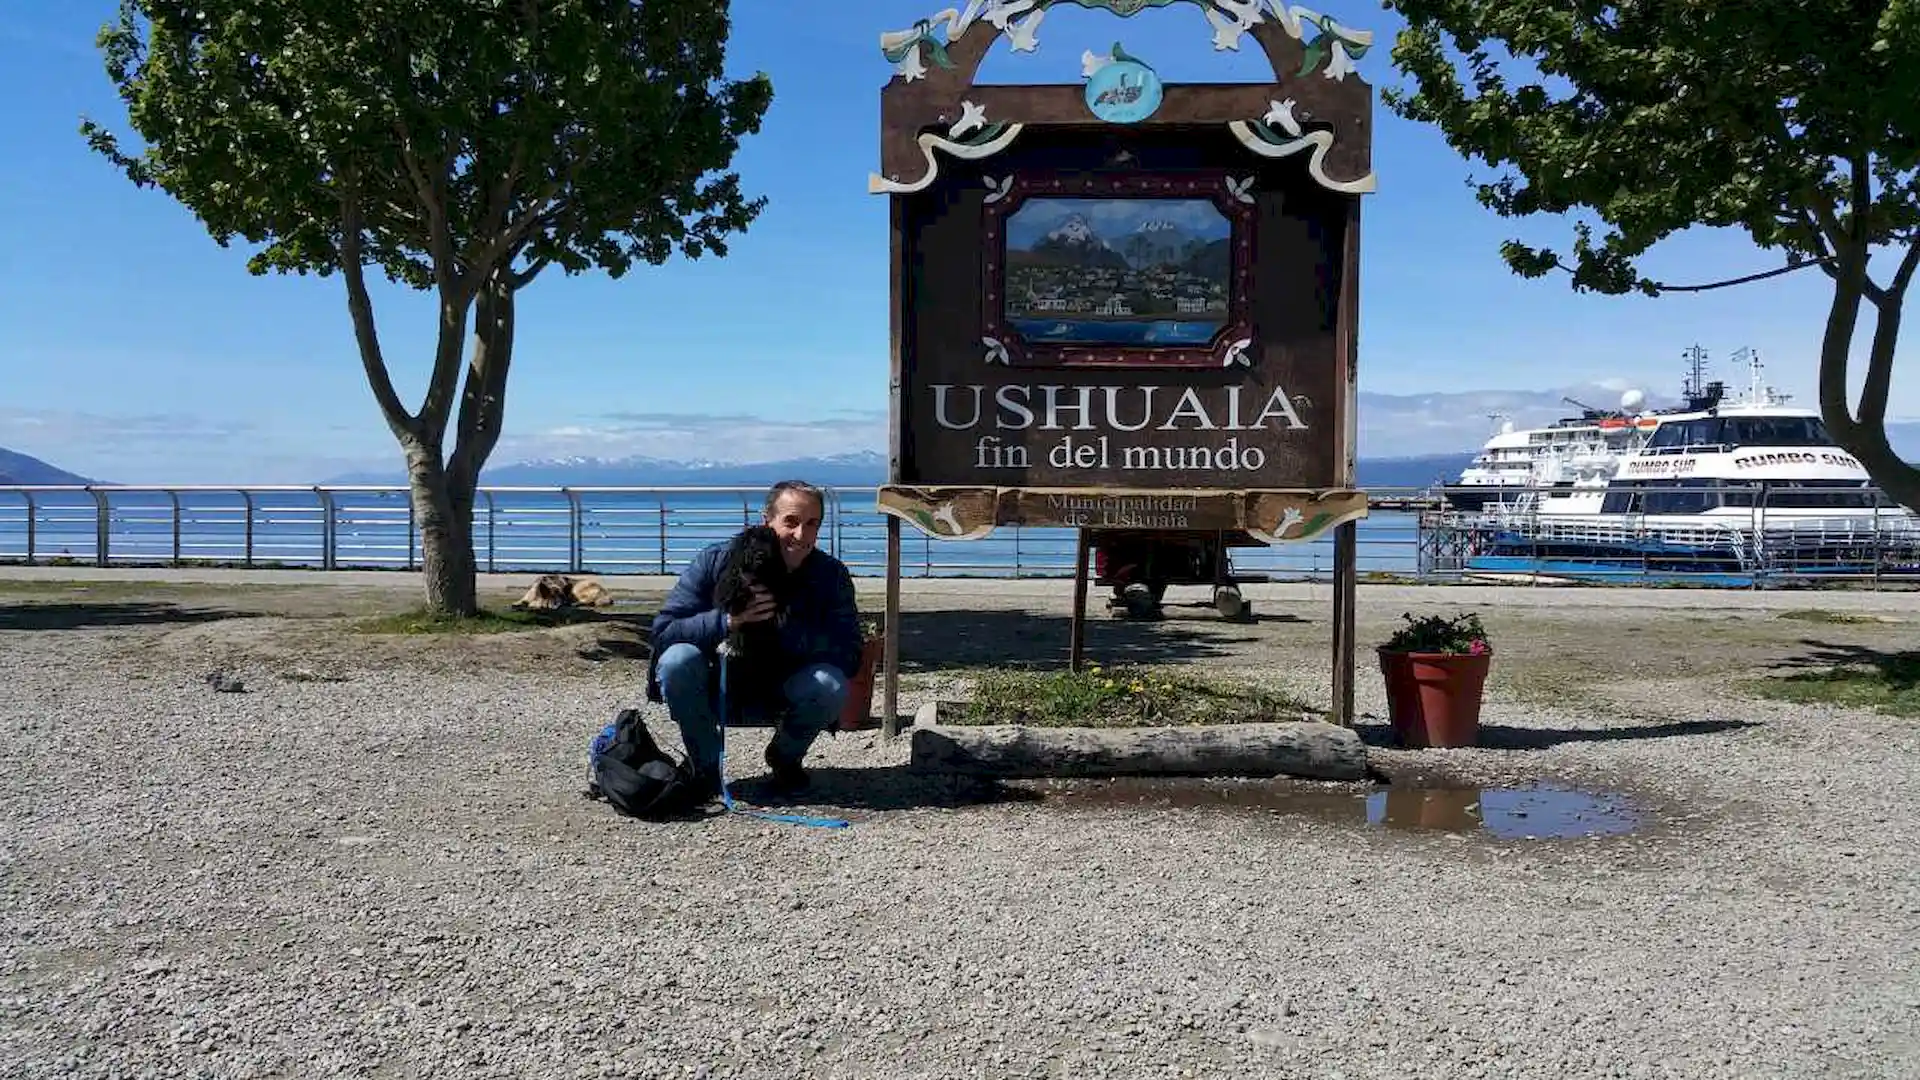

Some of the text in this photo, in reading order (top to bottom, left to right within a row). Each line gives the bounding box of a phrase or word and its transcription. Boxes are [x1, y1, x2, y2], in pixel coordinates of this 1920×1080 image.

[929, 384, 1309, 431] USHUAIA
[974, 435, 1266, 470] fin del mundo
[1735, 452, 1861, 470] RUMBO SUR
[1047, 492, 1198, 514] Municipalidad
[1063, 509, 1189, 528] de Ushuaia
